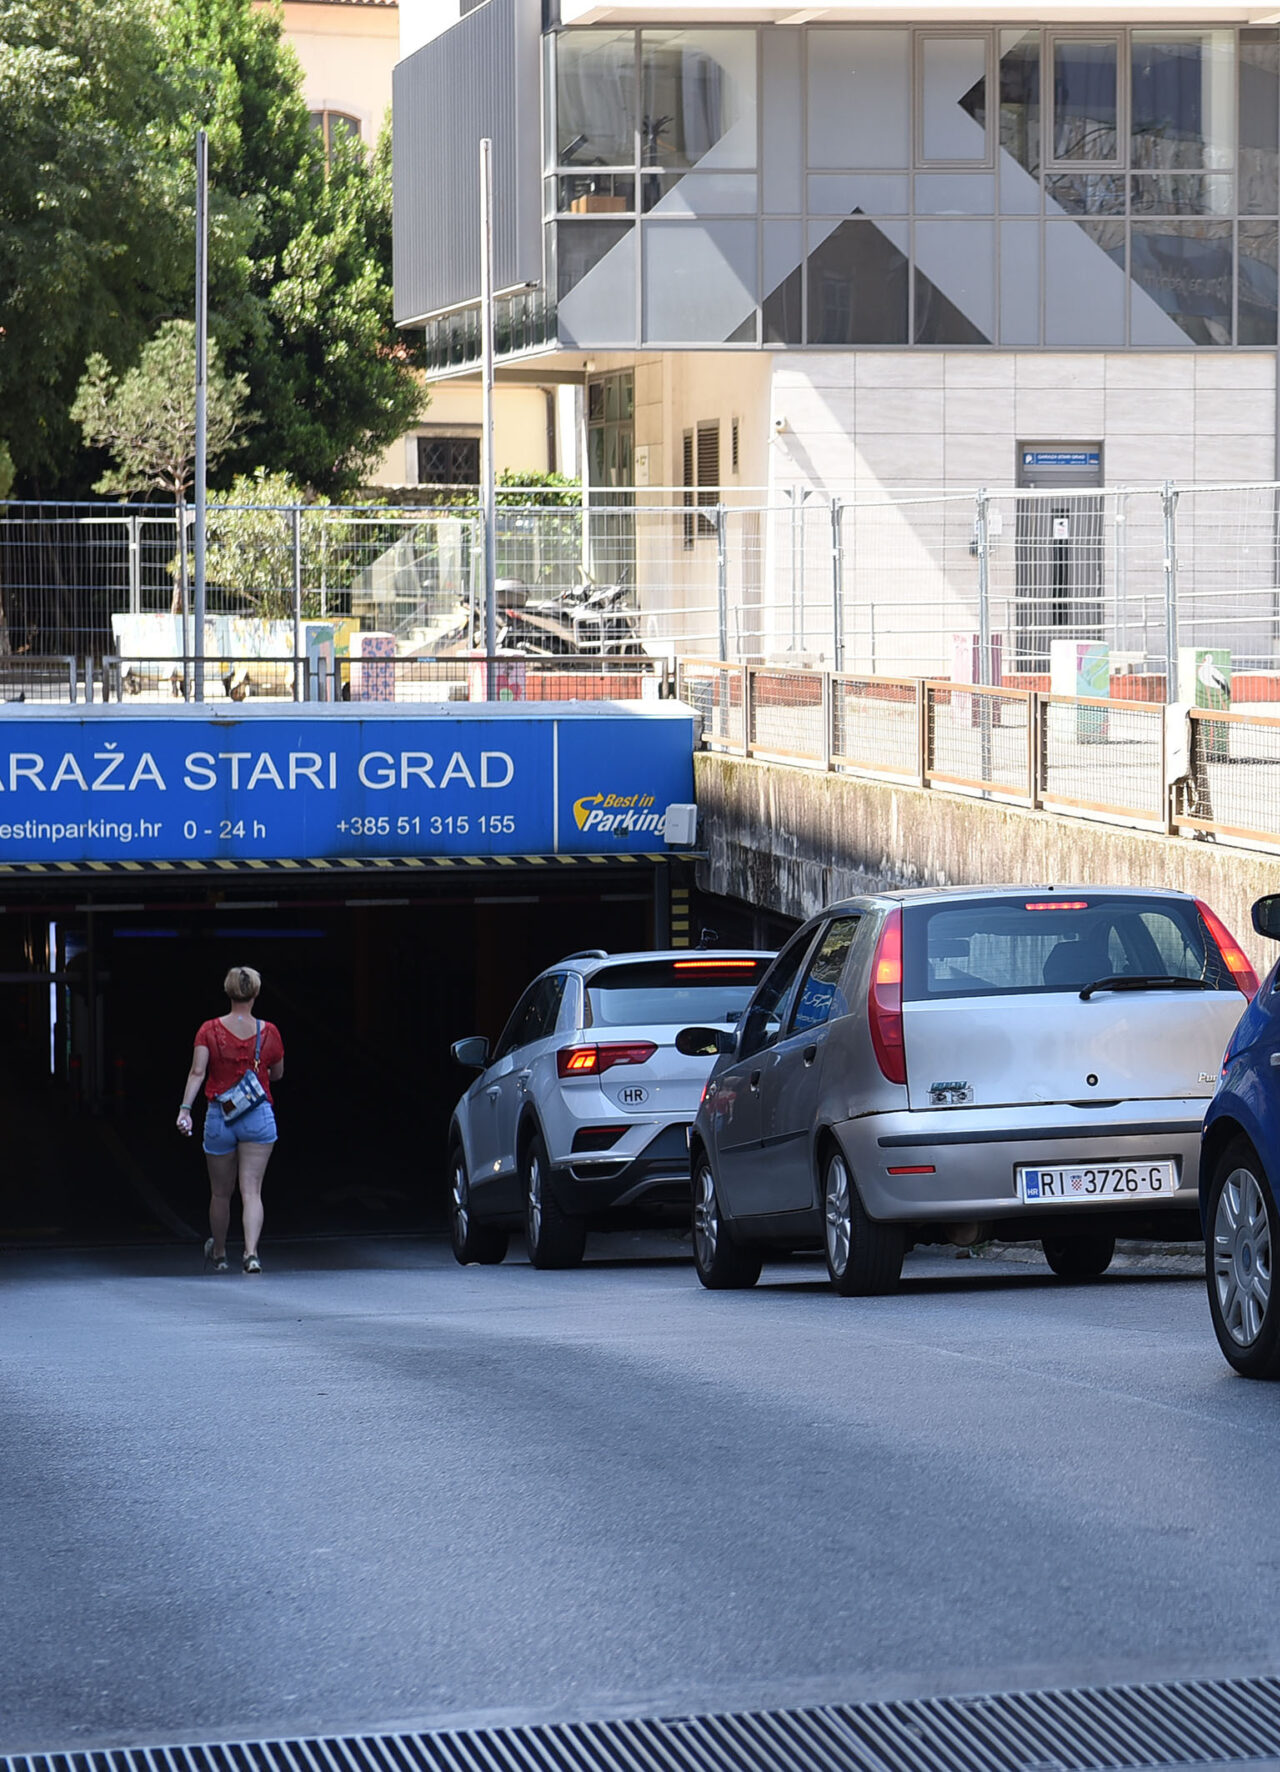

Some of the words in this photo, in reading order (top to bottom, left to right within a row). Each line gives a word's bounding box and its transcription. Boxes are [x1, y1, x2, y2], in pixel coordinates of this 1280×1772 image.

[0, 742, 167, 791] RAŽA
[183, 751, 337, 791] STARI
[358, 750, 515, 790] GRAD
[603, 793, 639, 808] Best
[638, 793, 656, 808] in
[183, 820, 198, 840] 0
[219, 820, 246, 840] 24
[252, 820, 267, 839] h
[336, 816, 390, 836] +385
[396, 816, 421, 835] 51
[429, 816, 469, 835] 315
[477, 815, 516, 834] 155
[582, 809, 667, 836] Parking
[624, 1088, 643, 1102] HR
[1027, 1187, 1039, 1196] HR
[1040, 1172, 1066, 1196] RI
[1083, 1167, 1163, 1194] 3726-G
